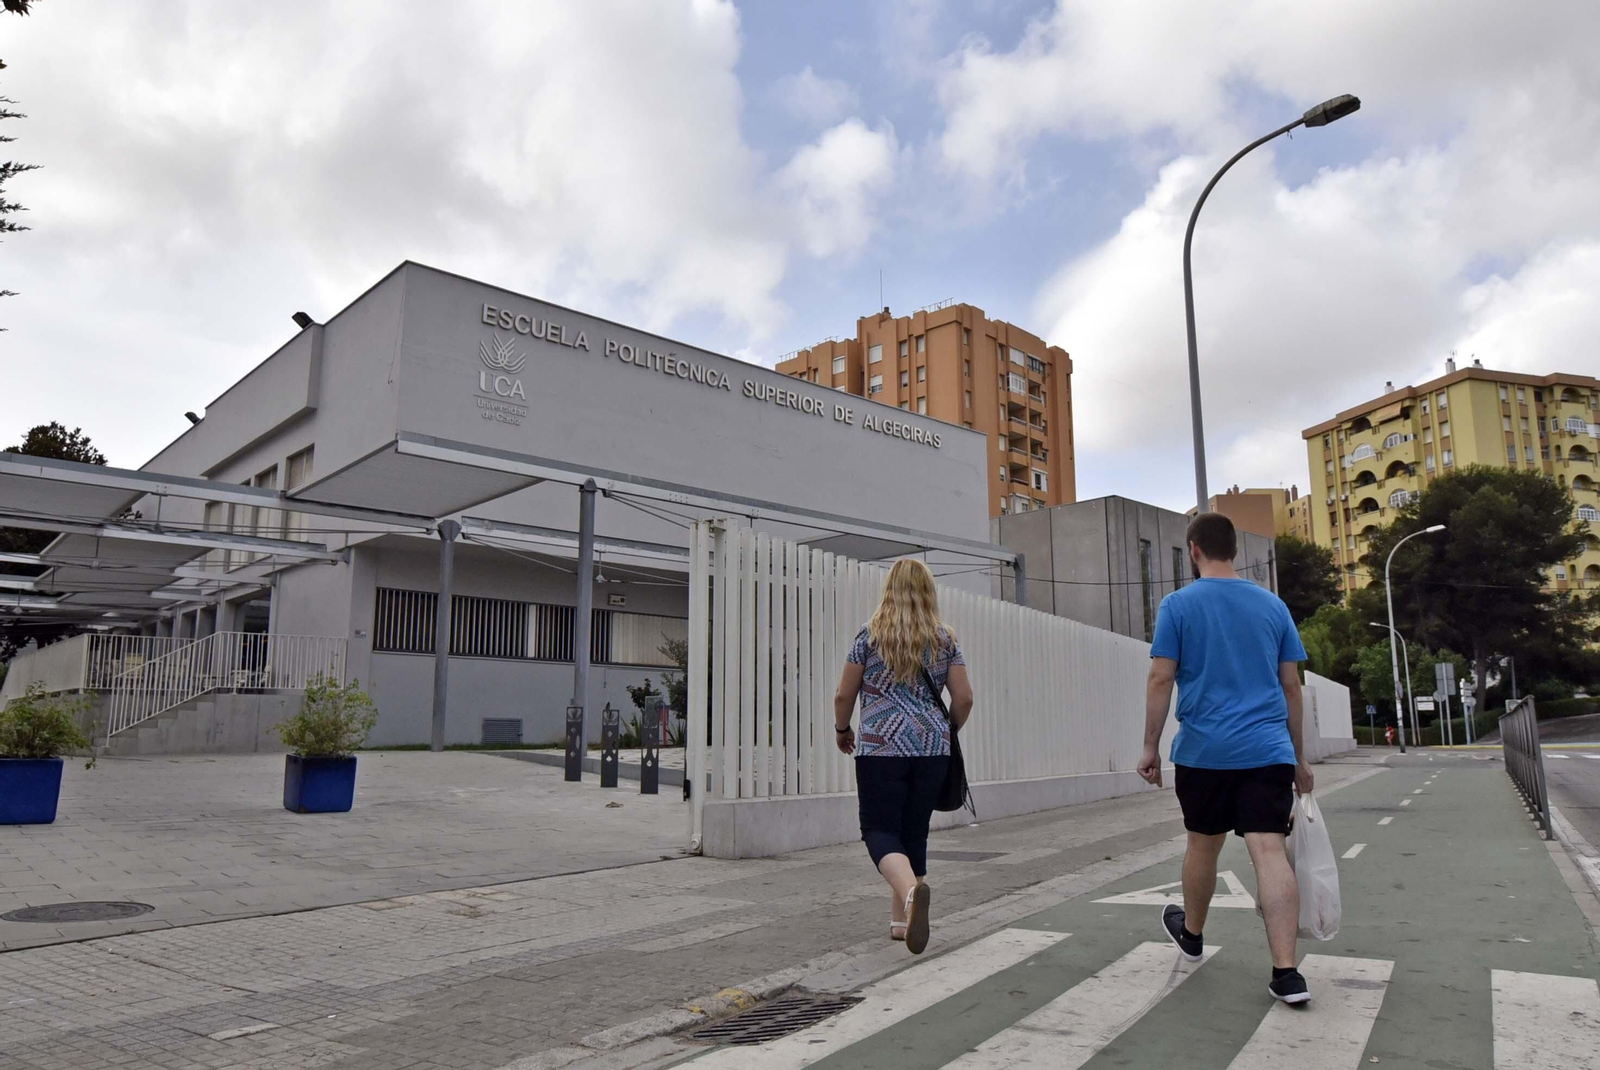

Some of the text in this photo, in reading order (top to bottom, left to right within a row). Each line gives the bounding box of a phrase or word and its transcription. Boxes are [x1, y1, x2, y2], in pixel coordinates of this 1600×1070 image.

[478, 371, 526, 400] UCA
[482, 302, 942, 448] ESCUELA POLITÉCNICA SUPERIOR DE ALGECIRAS
[477, 398, 527, 416] Universidad
[482, 410, 497, 420] de
